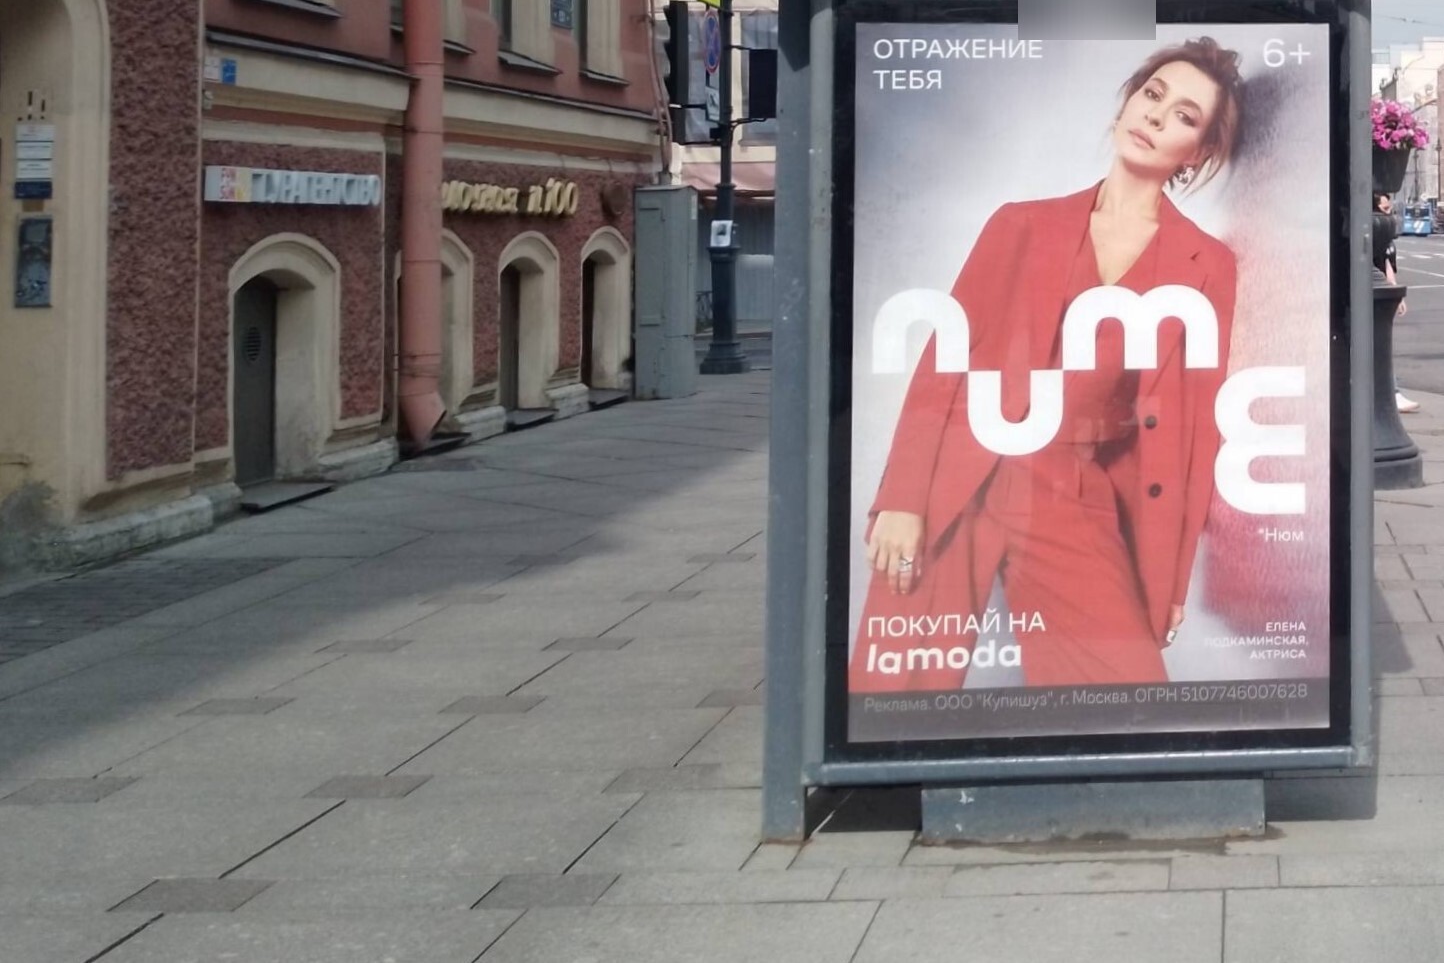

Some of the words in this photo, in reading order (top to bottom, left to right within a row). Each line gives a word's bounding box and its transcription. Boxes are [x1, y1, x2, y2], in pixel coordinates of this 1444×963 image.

[872, 38, 1043, 60] ОТРАЖЕНИЕ
[1262, 38, 1311, 68] 6+
[873, 69, 942, 90] ТЕБЯ
[868, 607, 1000, 638] ПОКУПАЙ
[1009, 611, 1046, 633] НА
[1265, 621, 1307, 633] ЕЛЕНА
[866, 640, 1022, 675] lamoda
[1249, 649, 1307, 660] АКТРИСА
[864, 697, 932, 712] Реклама.
[935, 695, 973, 710] ООО
[1072, 688, 1132, 706] Москва.
[1135, 687, 1177, 703] ОГРН
[1181, 683, 1308, 702] 5107746007628
